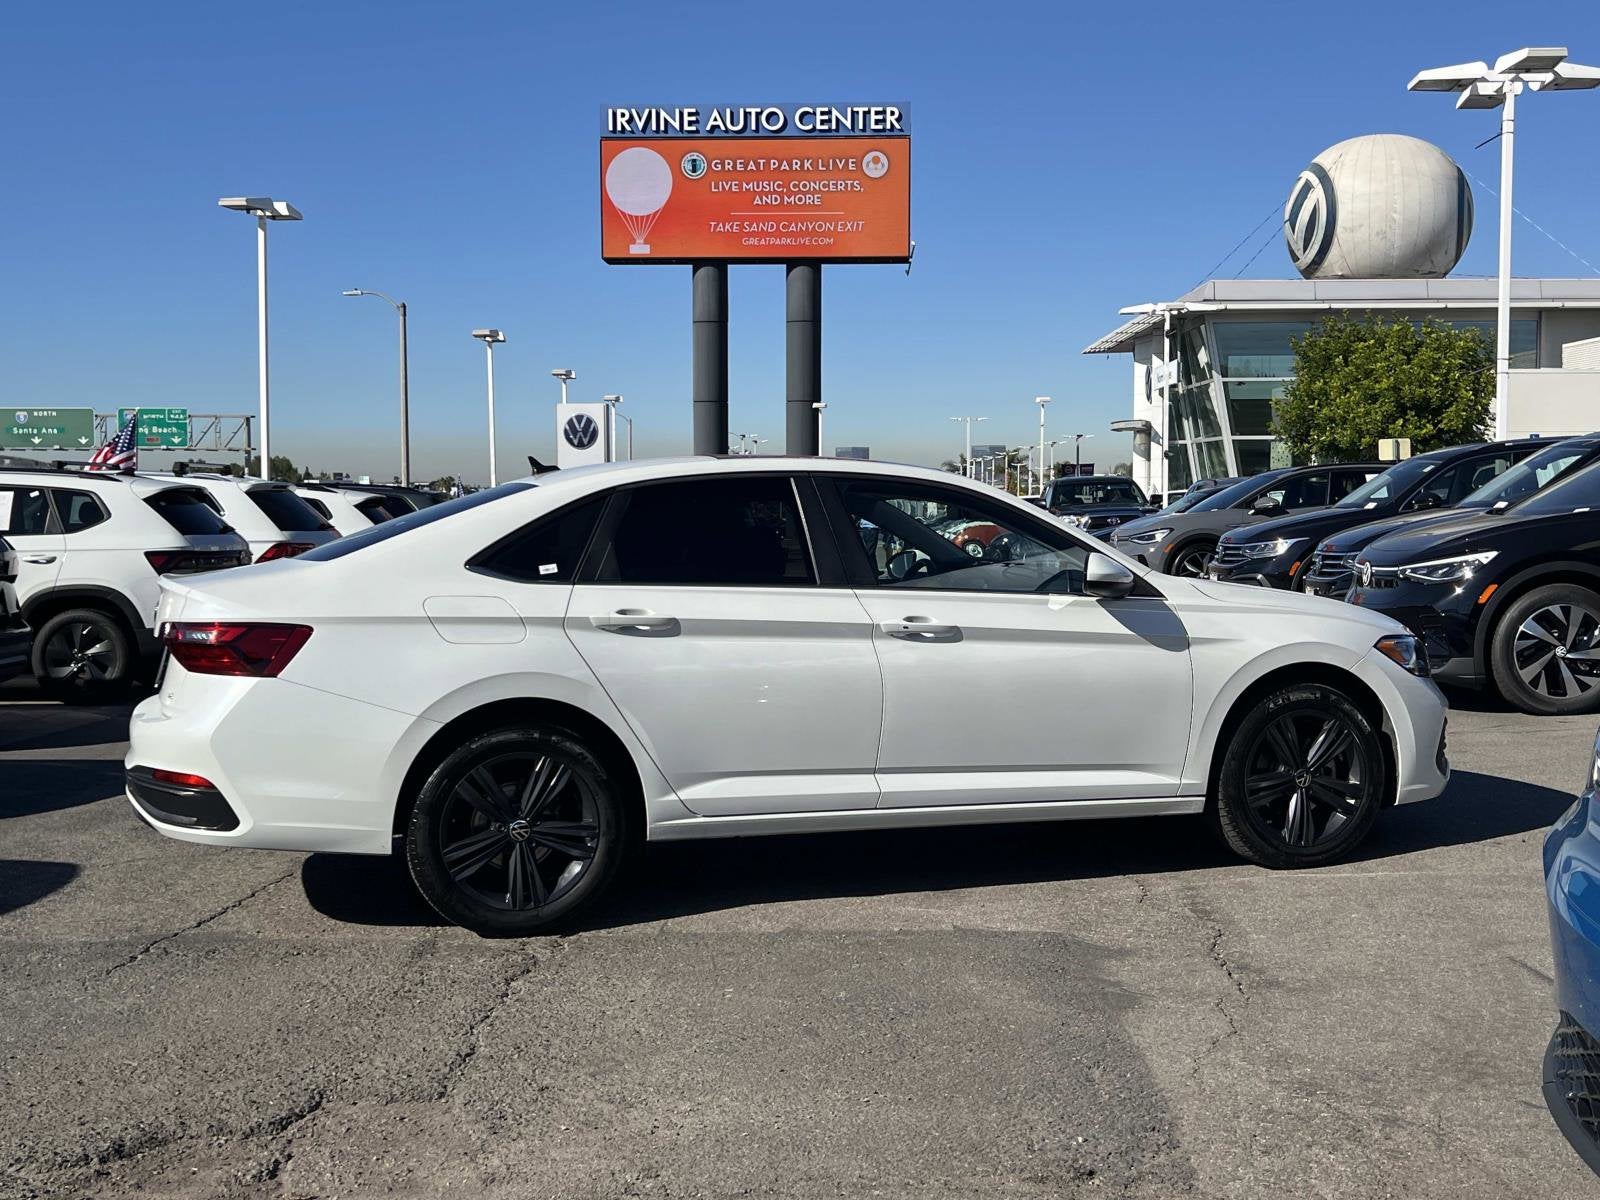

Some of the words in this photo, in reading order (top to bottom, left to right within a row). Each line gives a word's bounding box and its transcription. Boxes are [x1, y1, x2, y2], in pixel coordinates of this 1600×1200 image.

[607, 107, 697, 131] IRVINE
[705, 106, 785, 131] AUTO
[794, 105, 902, 131] CENTER
[711, 159, 766, 171] GREAT
[770, 159, 813, 171] PARK
[818, 158, 856, 171] LIVE
[711, 181, 740, 192] LIVE
[742, 180, 787, 193] MUSIC,
[753, 194, 781, 206] AND
[783, 194, 822, 205] MORE
[709, 221, 741, 233] TAKE
[742, 221, 777, 233] SAND
[779, 221, 834, 232] CANYON
[837, 220, 865, 232] EXIT
[742, 236, 834, 246] GREATPARKLIVE.COM
[12, 426, 38, 434] Santa
[41, 426, 58, 434] Ana
